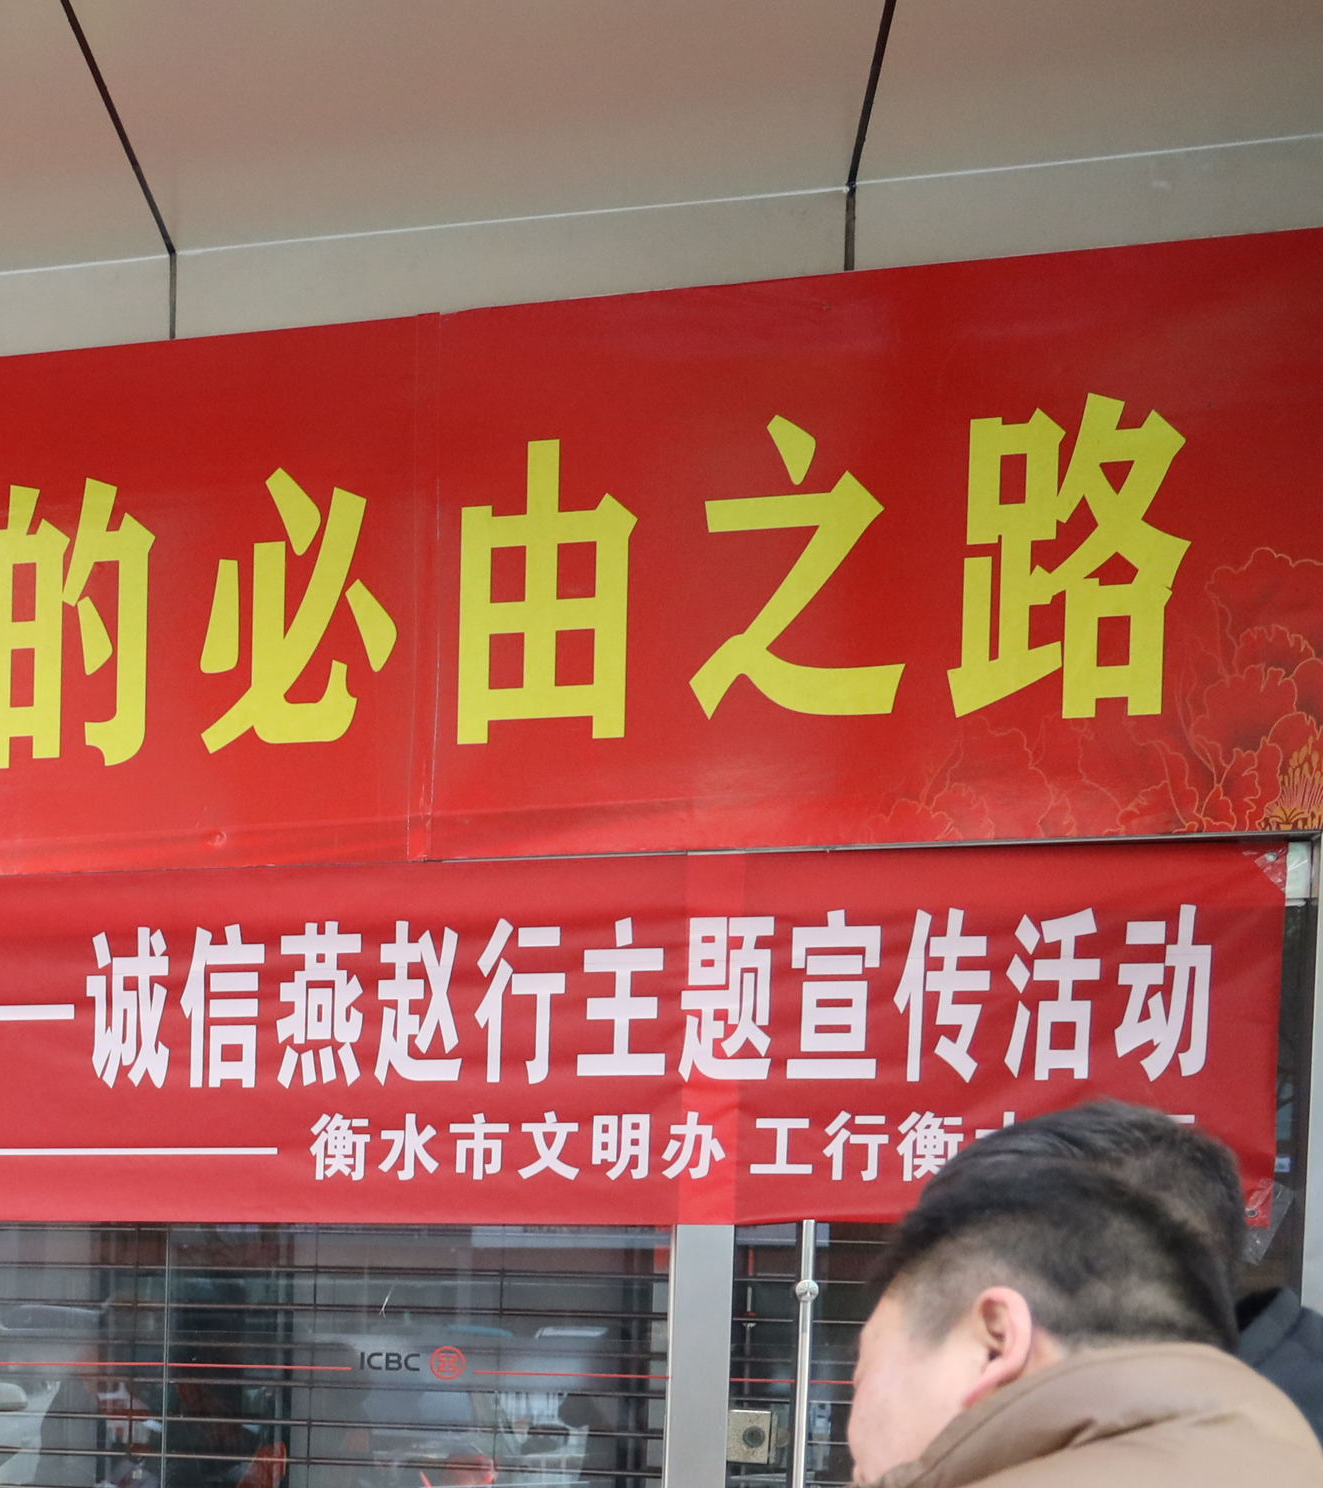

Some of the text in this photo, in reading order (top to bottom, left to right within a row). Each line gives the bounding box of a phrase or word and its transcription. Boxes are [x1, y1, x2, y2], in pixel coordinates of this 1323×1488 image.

[309, 1111, 726, 1181] 衡水市文明办
[359, 1351, 421, 1371] ICBC
